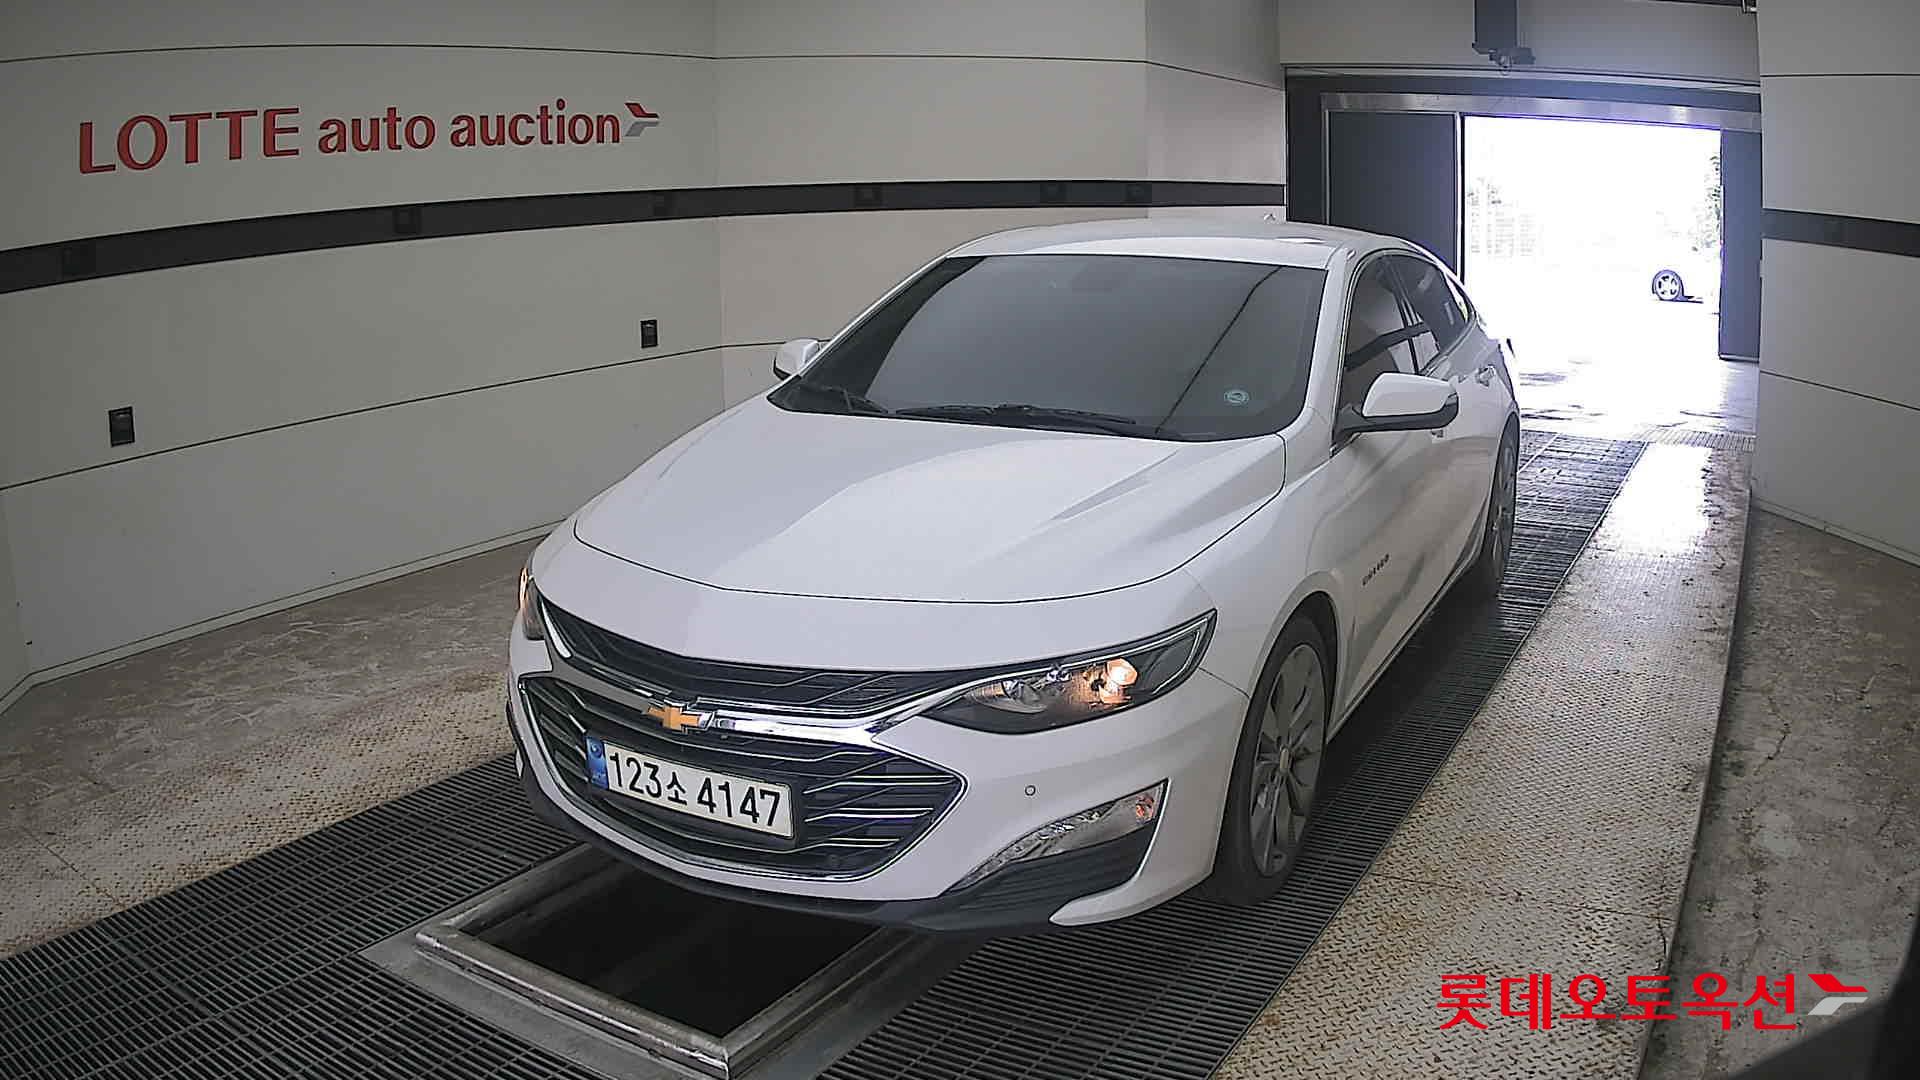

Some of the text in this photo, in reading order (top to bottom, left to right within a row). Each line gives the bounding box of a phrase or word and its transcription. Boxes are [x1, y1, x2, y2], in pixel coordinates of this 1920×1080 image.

[79, 99, 621, 174] LOTTE auto auction
[609, 752, 781, 827] 123소 4147
